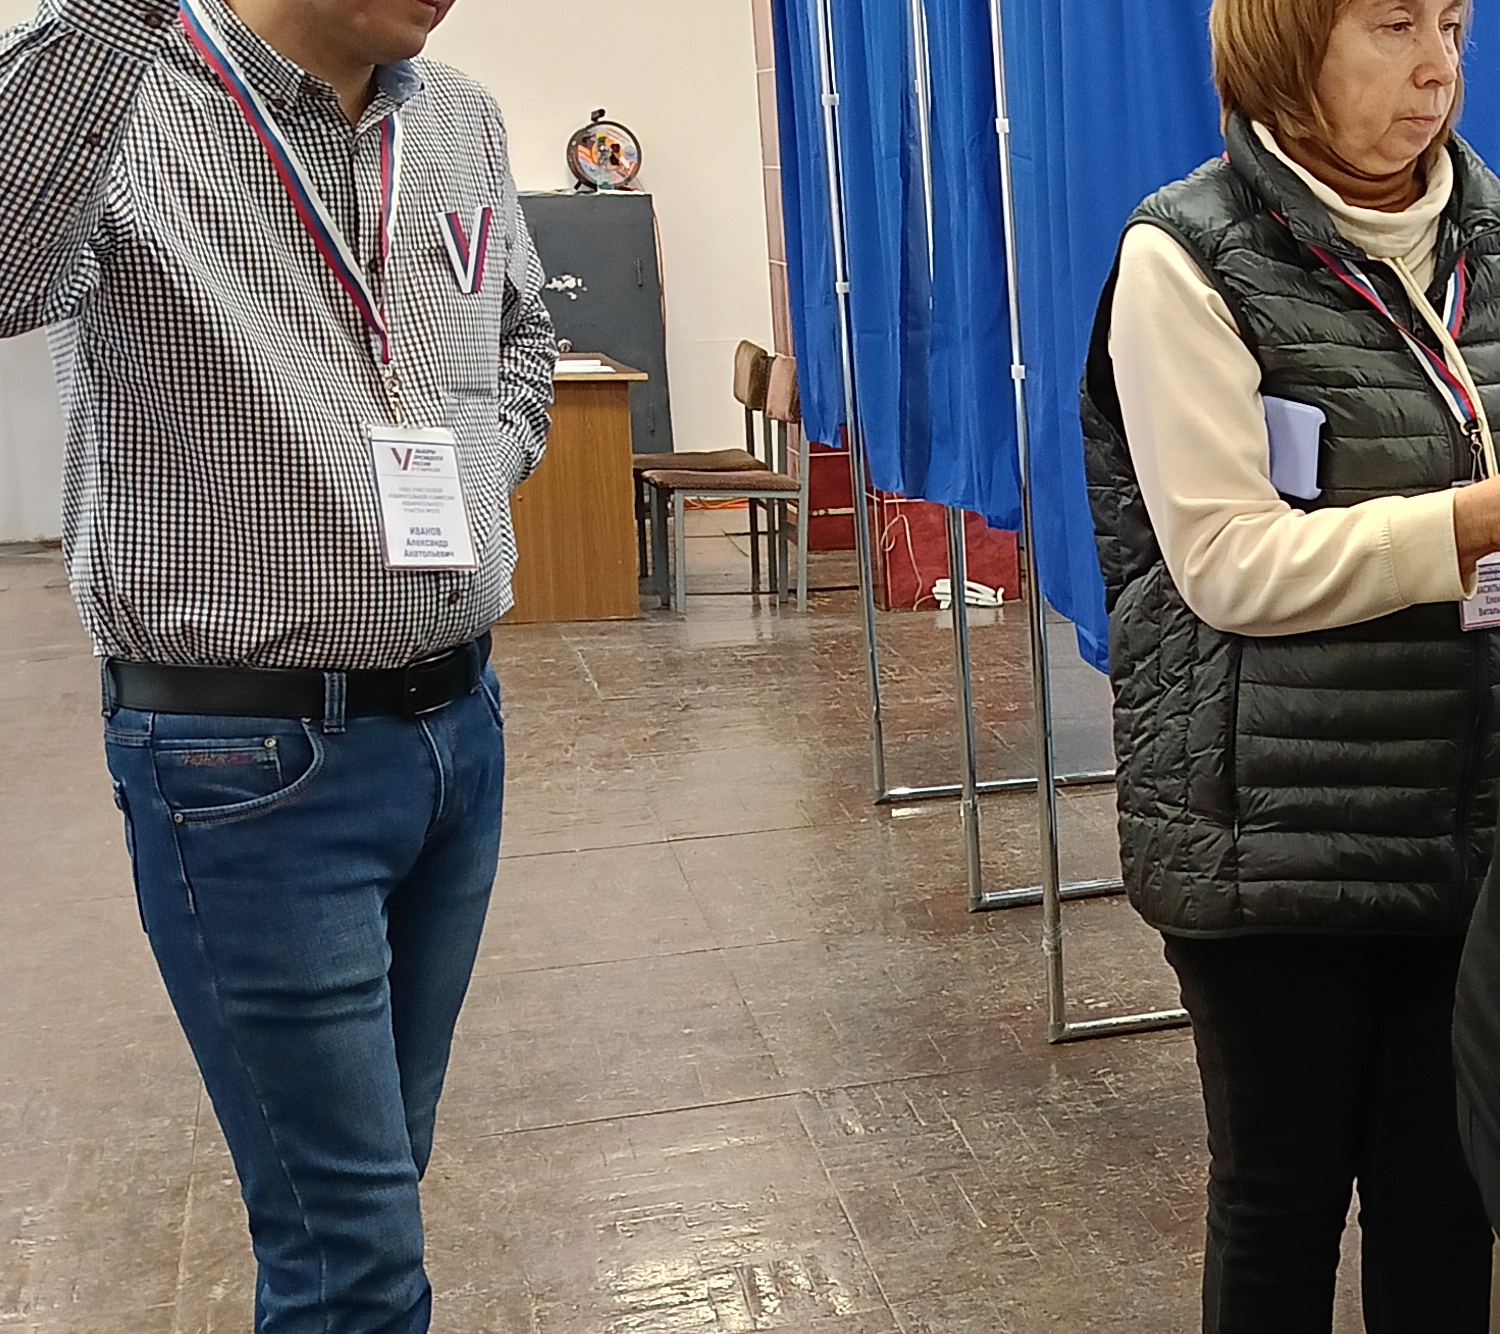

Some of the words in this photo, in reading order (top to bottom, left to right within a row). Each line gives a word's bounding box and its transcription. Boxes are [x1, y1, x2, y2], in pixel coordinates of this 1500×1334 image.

[409, 527, 441, 536] ИВАНОВ
[406, 538, 449, 548] Александр
[404, 549, 455, 558] Анатольевич
